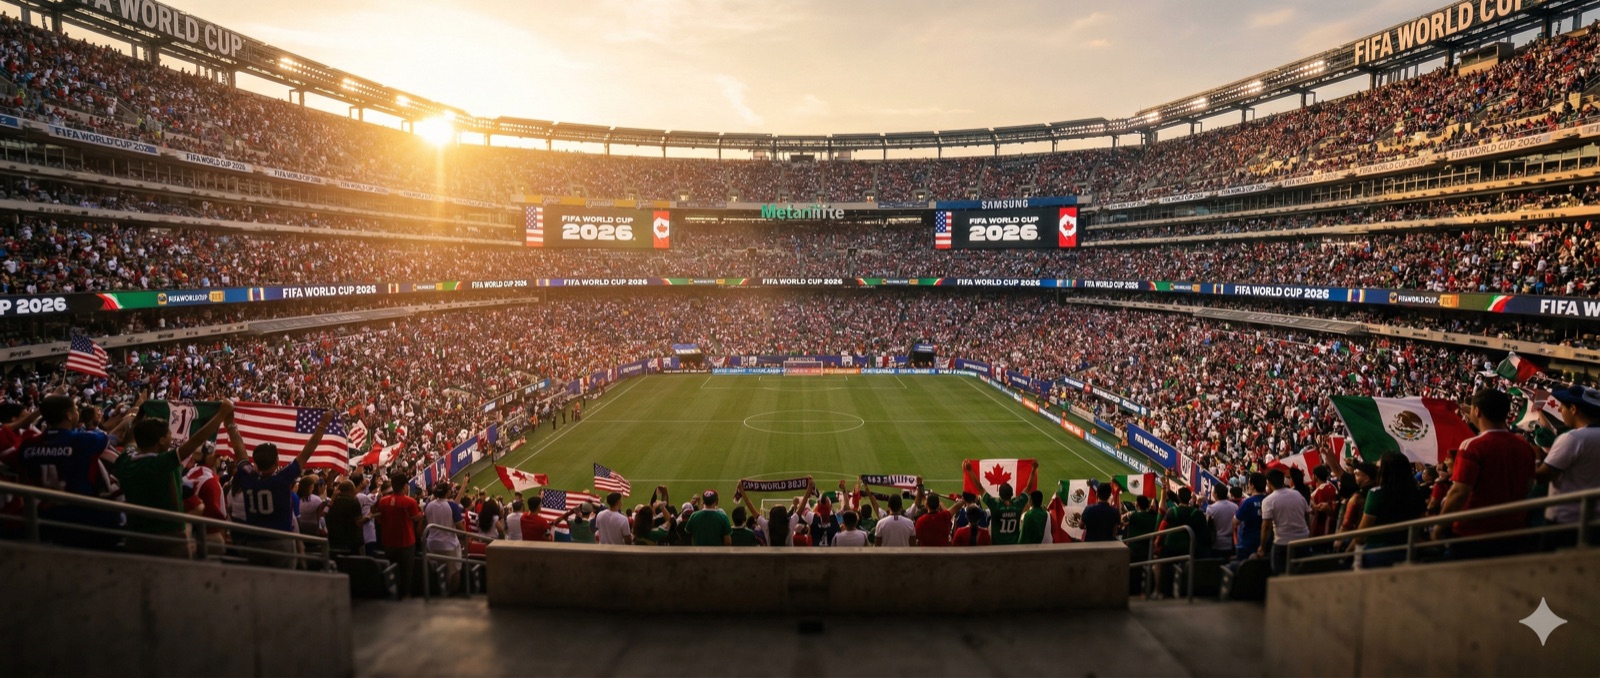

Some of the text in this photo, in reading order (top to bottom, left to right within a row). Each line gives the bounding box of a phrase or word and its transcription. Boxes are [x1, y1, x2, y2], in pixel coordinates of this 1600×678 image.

[120, 0, 242, 57] WORLD CUP
[1355, 32, 1394, 66] FIFA
[1398, 2, 1473, 50] WORLD
[55, 127, 80, 139] FIFA
[80, 132, 113, 144] WORLD
[114, 138, 132, 149] CUP
[1451, 136, 1541, 159] FIFA WORLD CUP 2026
[186, 154, 200, 162] FIFA
[200, 156, 220, 166] WORLD
[221, 159, 232, 167] CUP
[1394, 161, 1407, 169] CUP
[1408, 159, 1426, 167] 2026
[982, 200, 1028, 209] SAMSUNG
[562, 224, 633, 240] 2026
[969, 224, 1038, 241] 2026
[283, 285, 376, 298] FIFA WORLD CUP 2026
[1235, 286, 1329, 299] FIFA WORLD CUP 2026
[16, 297, 67, 314] 2026
[1540, 299, 1579, 316] FIFA
[1135, 433, 1168, 460] FIFA WORLD CUP
[458, 449, 467, 463] FIFA
[760, 482, 786, 490] WORLD
[246, 489, 274, 514] 10
[1000, 519, 1017, 533] 10
